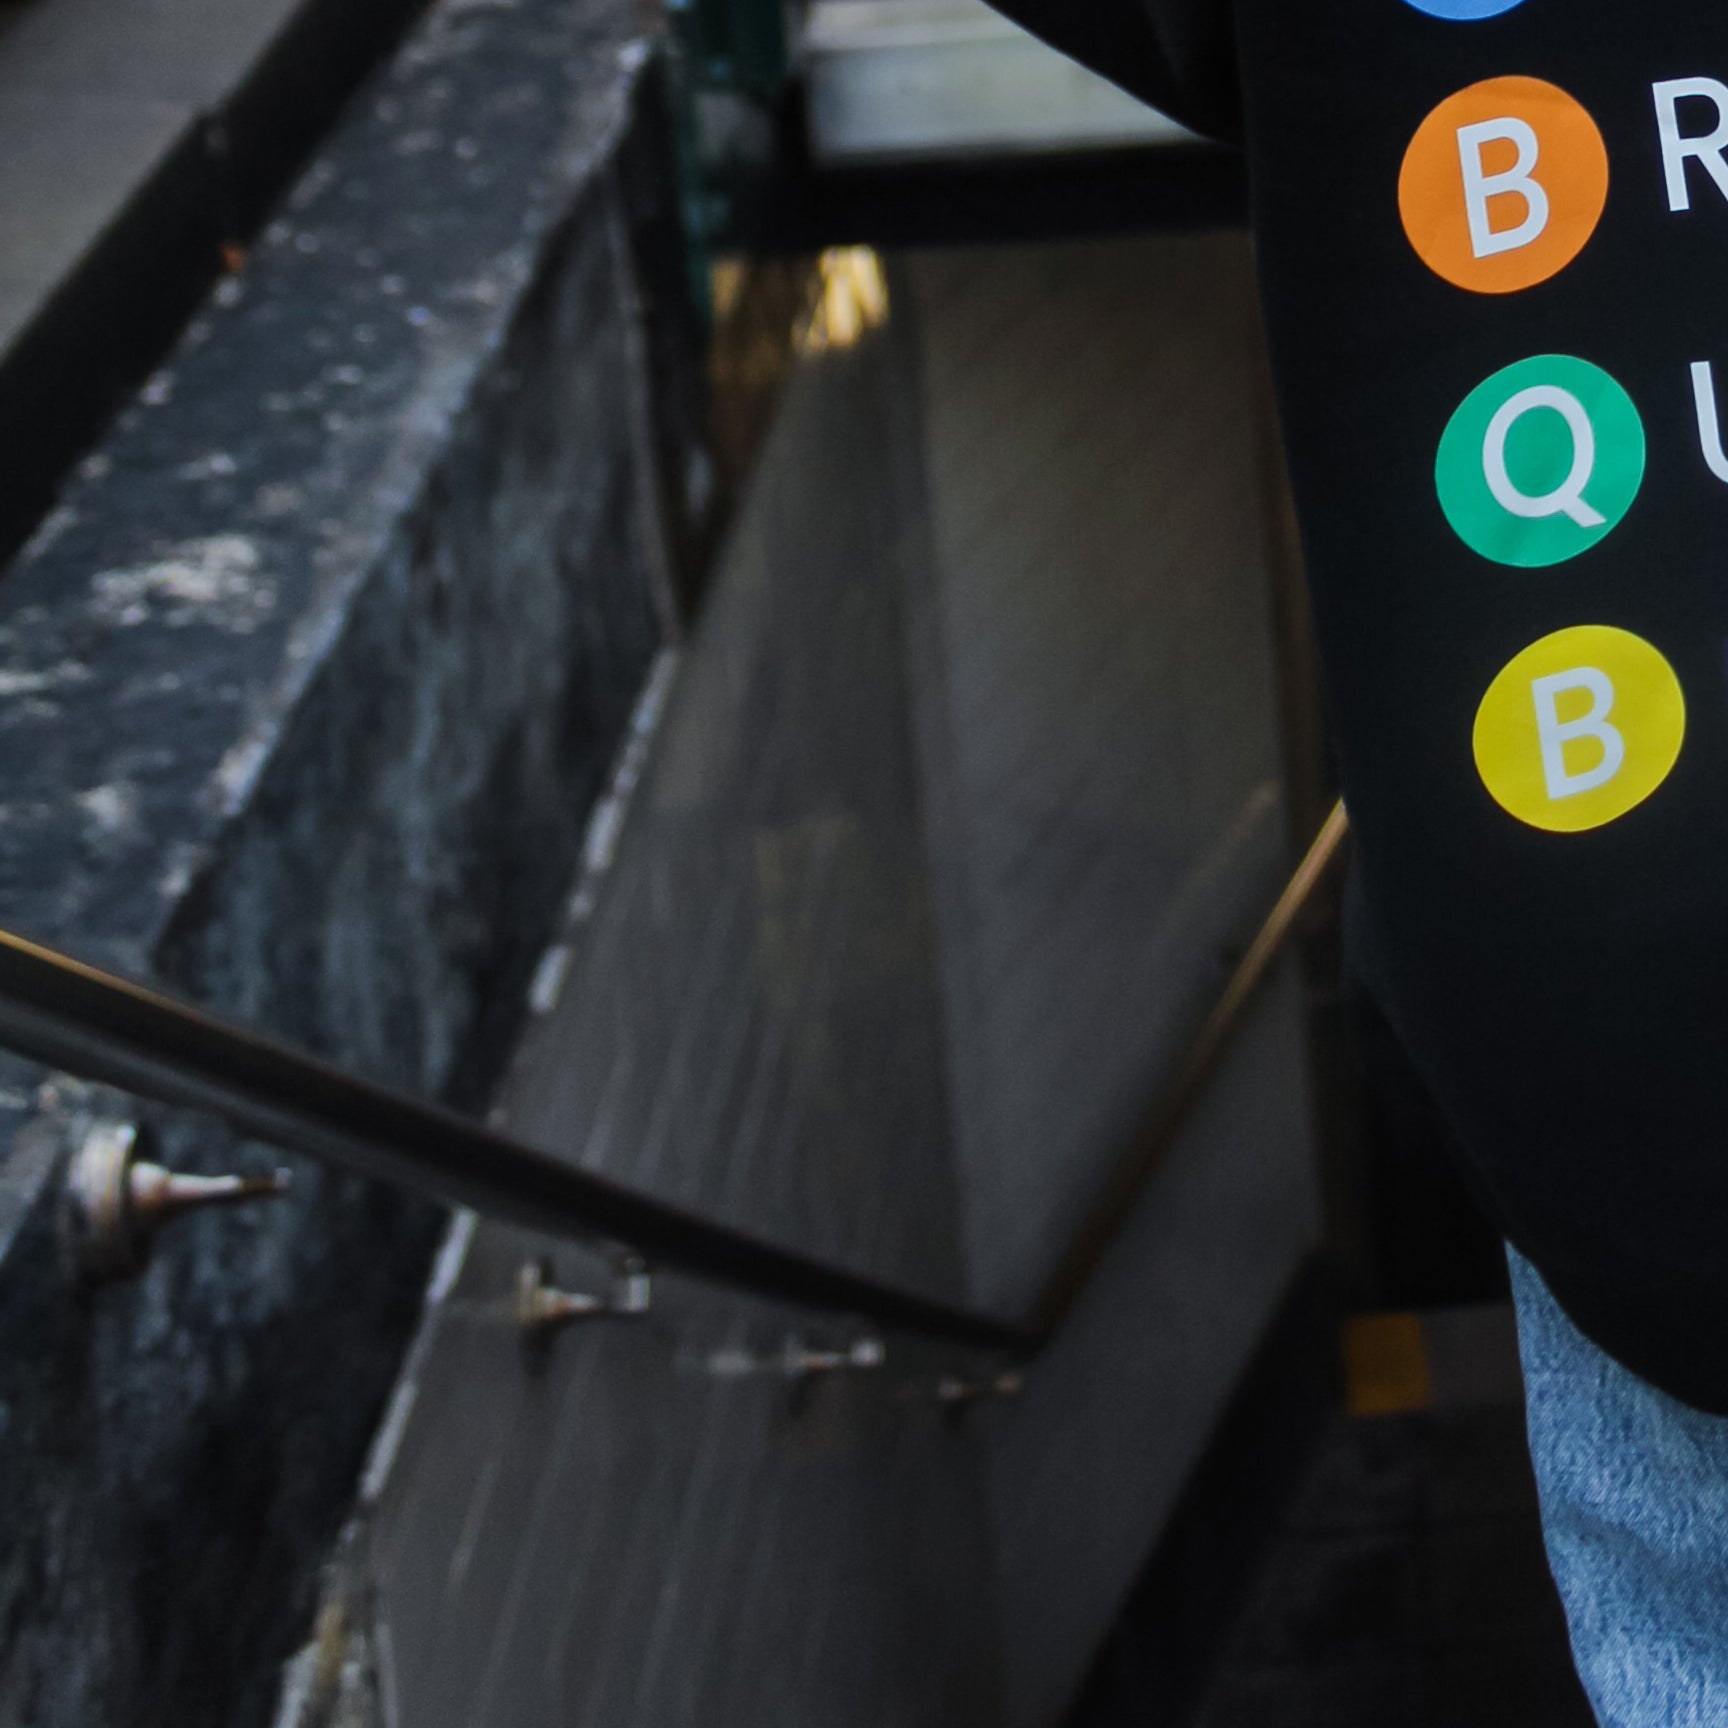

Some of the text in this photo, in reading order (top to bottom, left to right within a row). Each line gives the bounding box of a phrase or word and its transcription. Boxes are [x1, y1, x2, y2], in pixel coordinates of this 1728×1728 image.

[1455, 115, 1550, 259] B
[1482, 384, 1607, 529] Q
[1530, 665, 1626, 802] B
